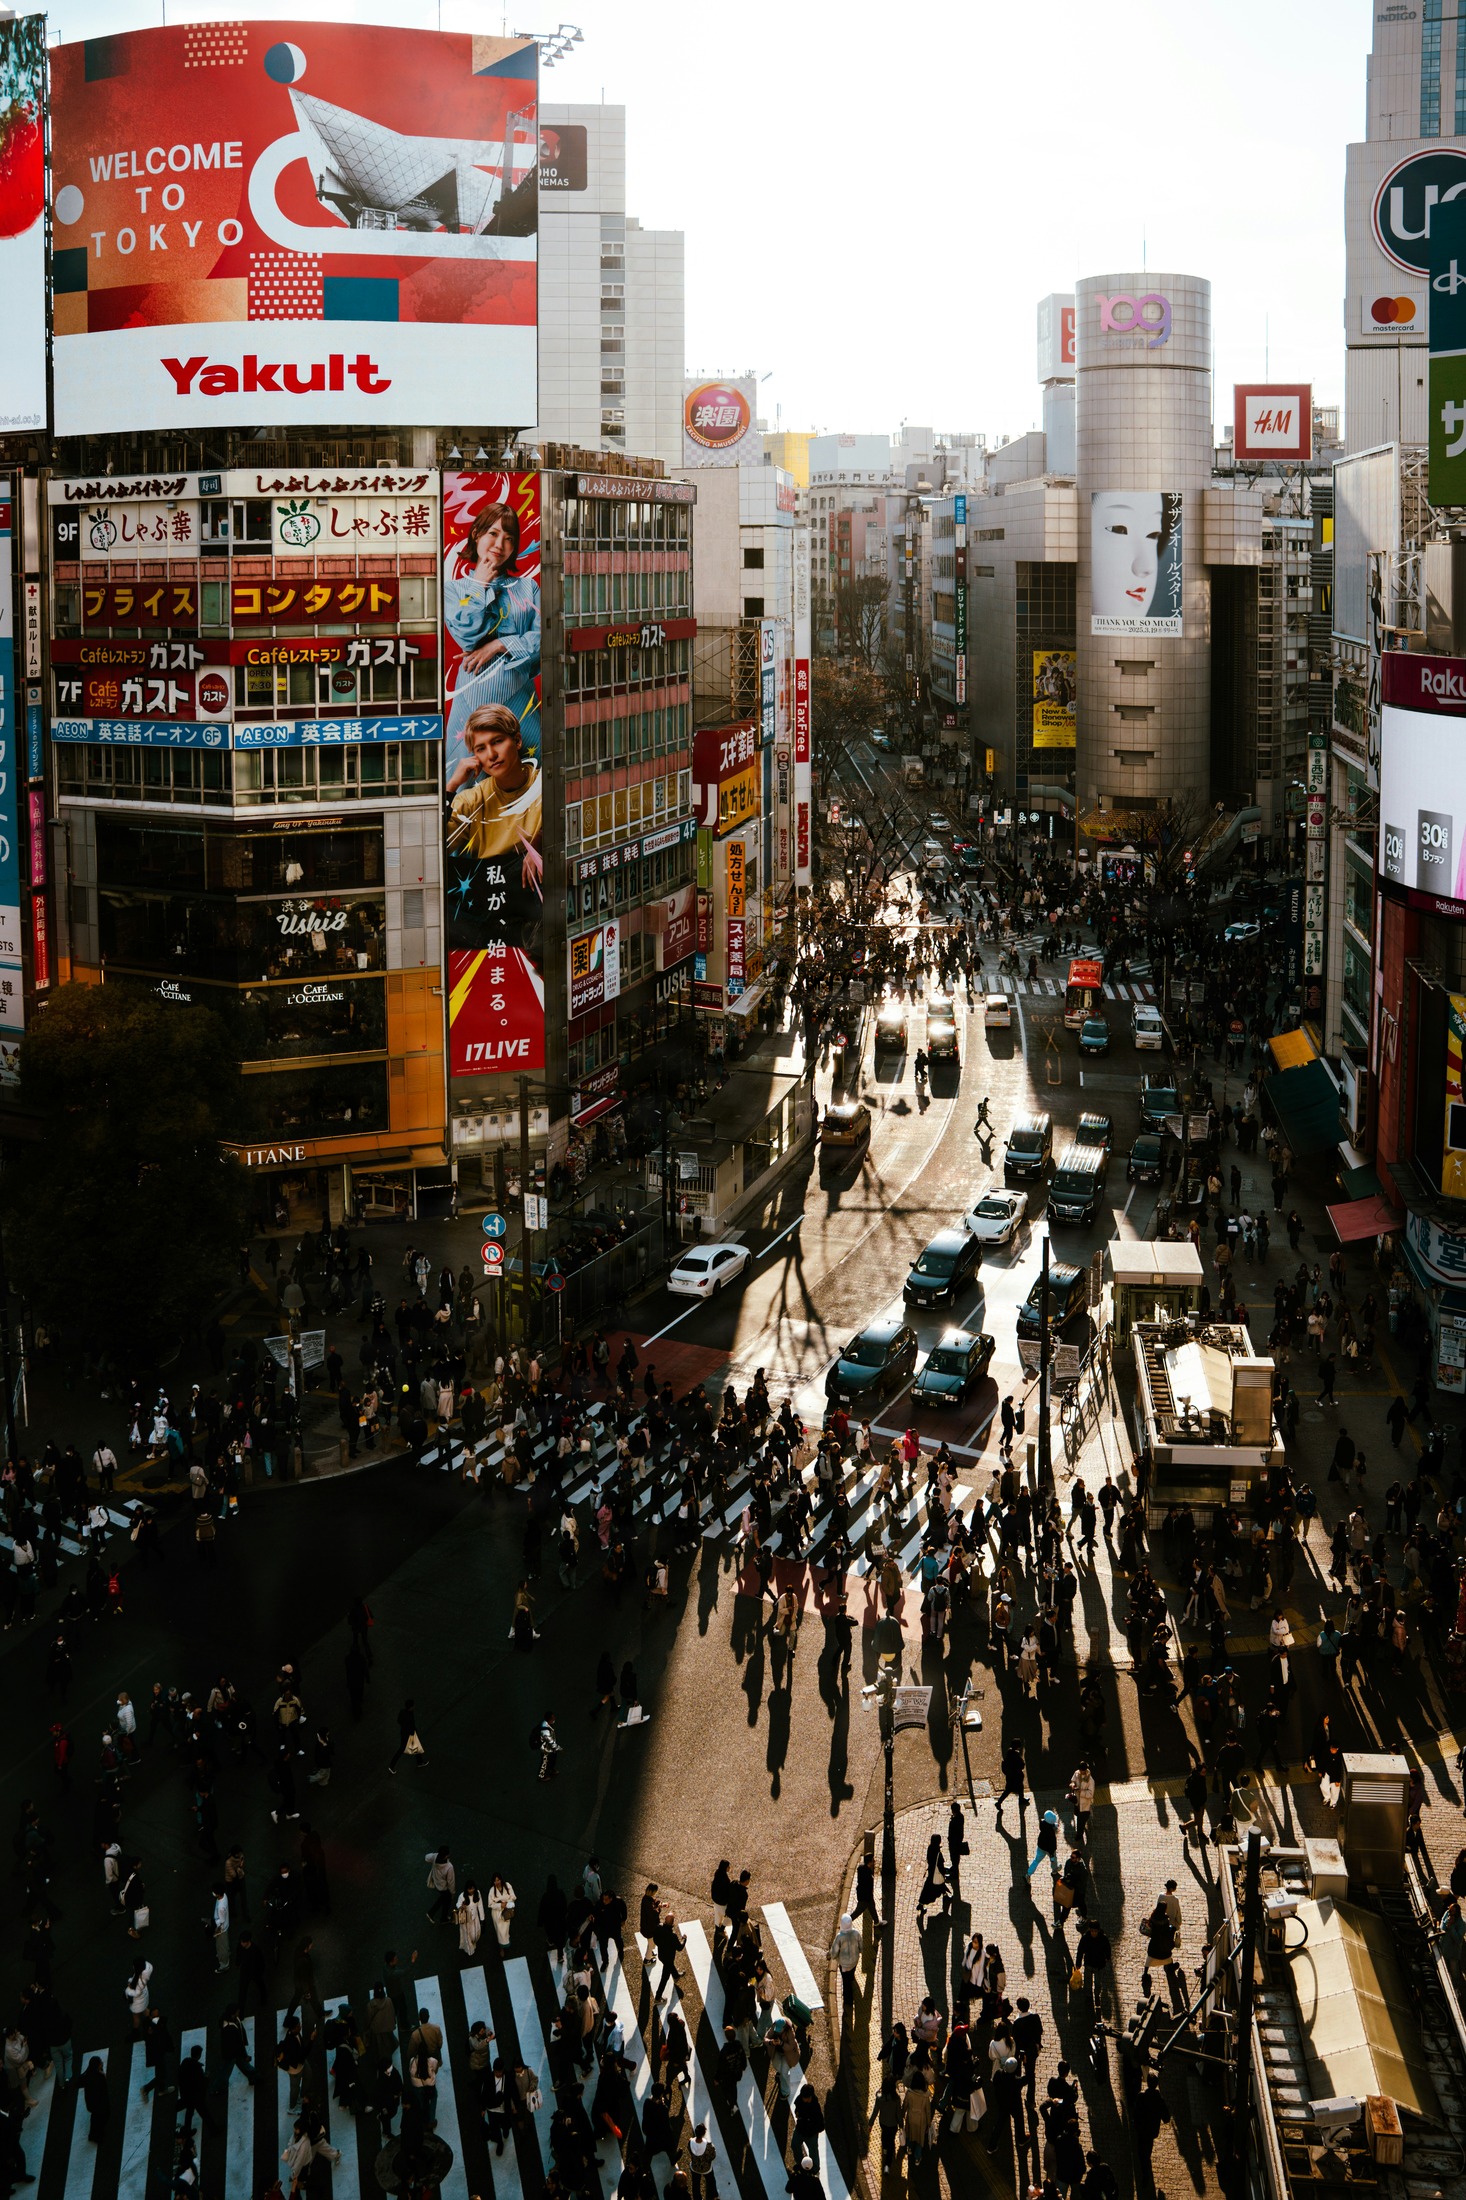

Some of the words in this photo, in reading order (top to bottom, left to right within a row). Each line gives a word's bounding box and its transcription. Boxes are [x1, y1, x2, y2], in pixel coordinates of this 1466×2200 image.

[1377, 11, 1417, 22] INDIGO
[89, 142, 243, 183] WELCOME
[135, 183, 185, 214] TO
[91, 218, 244, 258] TOKYO
[1094, 293, 1173, 349] 109
[1372, 324, 1415, 332] mastercard
[161, 354, 391, 396] Yakult
[694, 404, 741, 427] 楽園
[1254, 409, 1293, 435] H&M
[685, 424, 711, 447] EXCITING
[712, 424, 748, 449] AMUSEMENT
[64, 477, 188, 501] しゃぶしゃぶバイキング
[256, 474, 430, 493] しゃぶしゃぶバイキング
[57, 522, 79, 542] 9F
[121, 509, 192, 543] しゃぶ葉
[330, 503, 431, 538] しゃぶ葉
[85, 587, 196, 617] プライス
[233, 583, 393, 615] コンタクト
[641, 624, 667, 649] ガスト
[1096, 618, 1120, 627] THANK
[1121, 619, 1136, 627] YOU
[150, 641, 205, 671] ガスト
[346, 638, 420, 668] ガスト
[58, 681, 83, 702] 7F
[89, 680, 118, 697] Café
[121, 676, 189, 714] ガスト
[202, 690, 226, 703] ガスト
[55, 721, 89, 740] AEON
[98, 722, 197, 744] 英会話イーオン
[241, 726, 288, 744] AEON
[301, 719, 439, 744] 英会話イーオン
[797, 699, 808, 753] TaxFree
[579, 859, 598, 880] 薄毛
[684, 820, 696, 840] 4F
[34, 874, 44, 884] 4F
[730, 843, 744, 895] 処方せん
[36, 896, 46, 942] 外貨両替
[732, 896, 740, 914] 3F
[1291, 888, 1299, 923] MIZUHO
[1435, 899, 1465, 915] Rakuten
[276, 911, 348, 936] Ushi8
[668, 915, 690, 944] アコム
[699, 918, 707, 942] アコム
[486, 864, 508, 1027] 私が、始まる。
[729, 922, 744, 977] スギ薬局
[571, 981, 605, 1010] サンドラッグ
[656, 966, 687, 1004] LUSH
